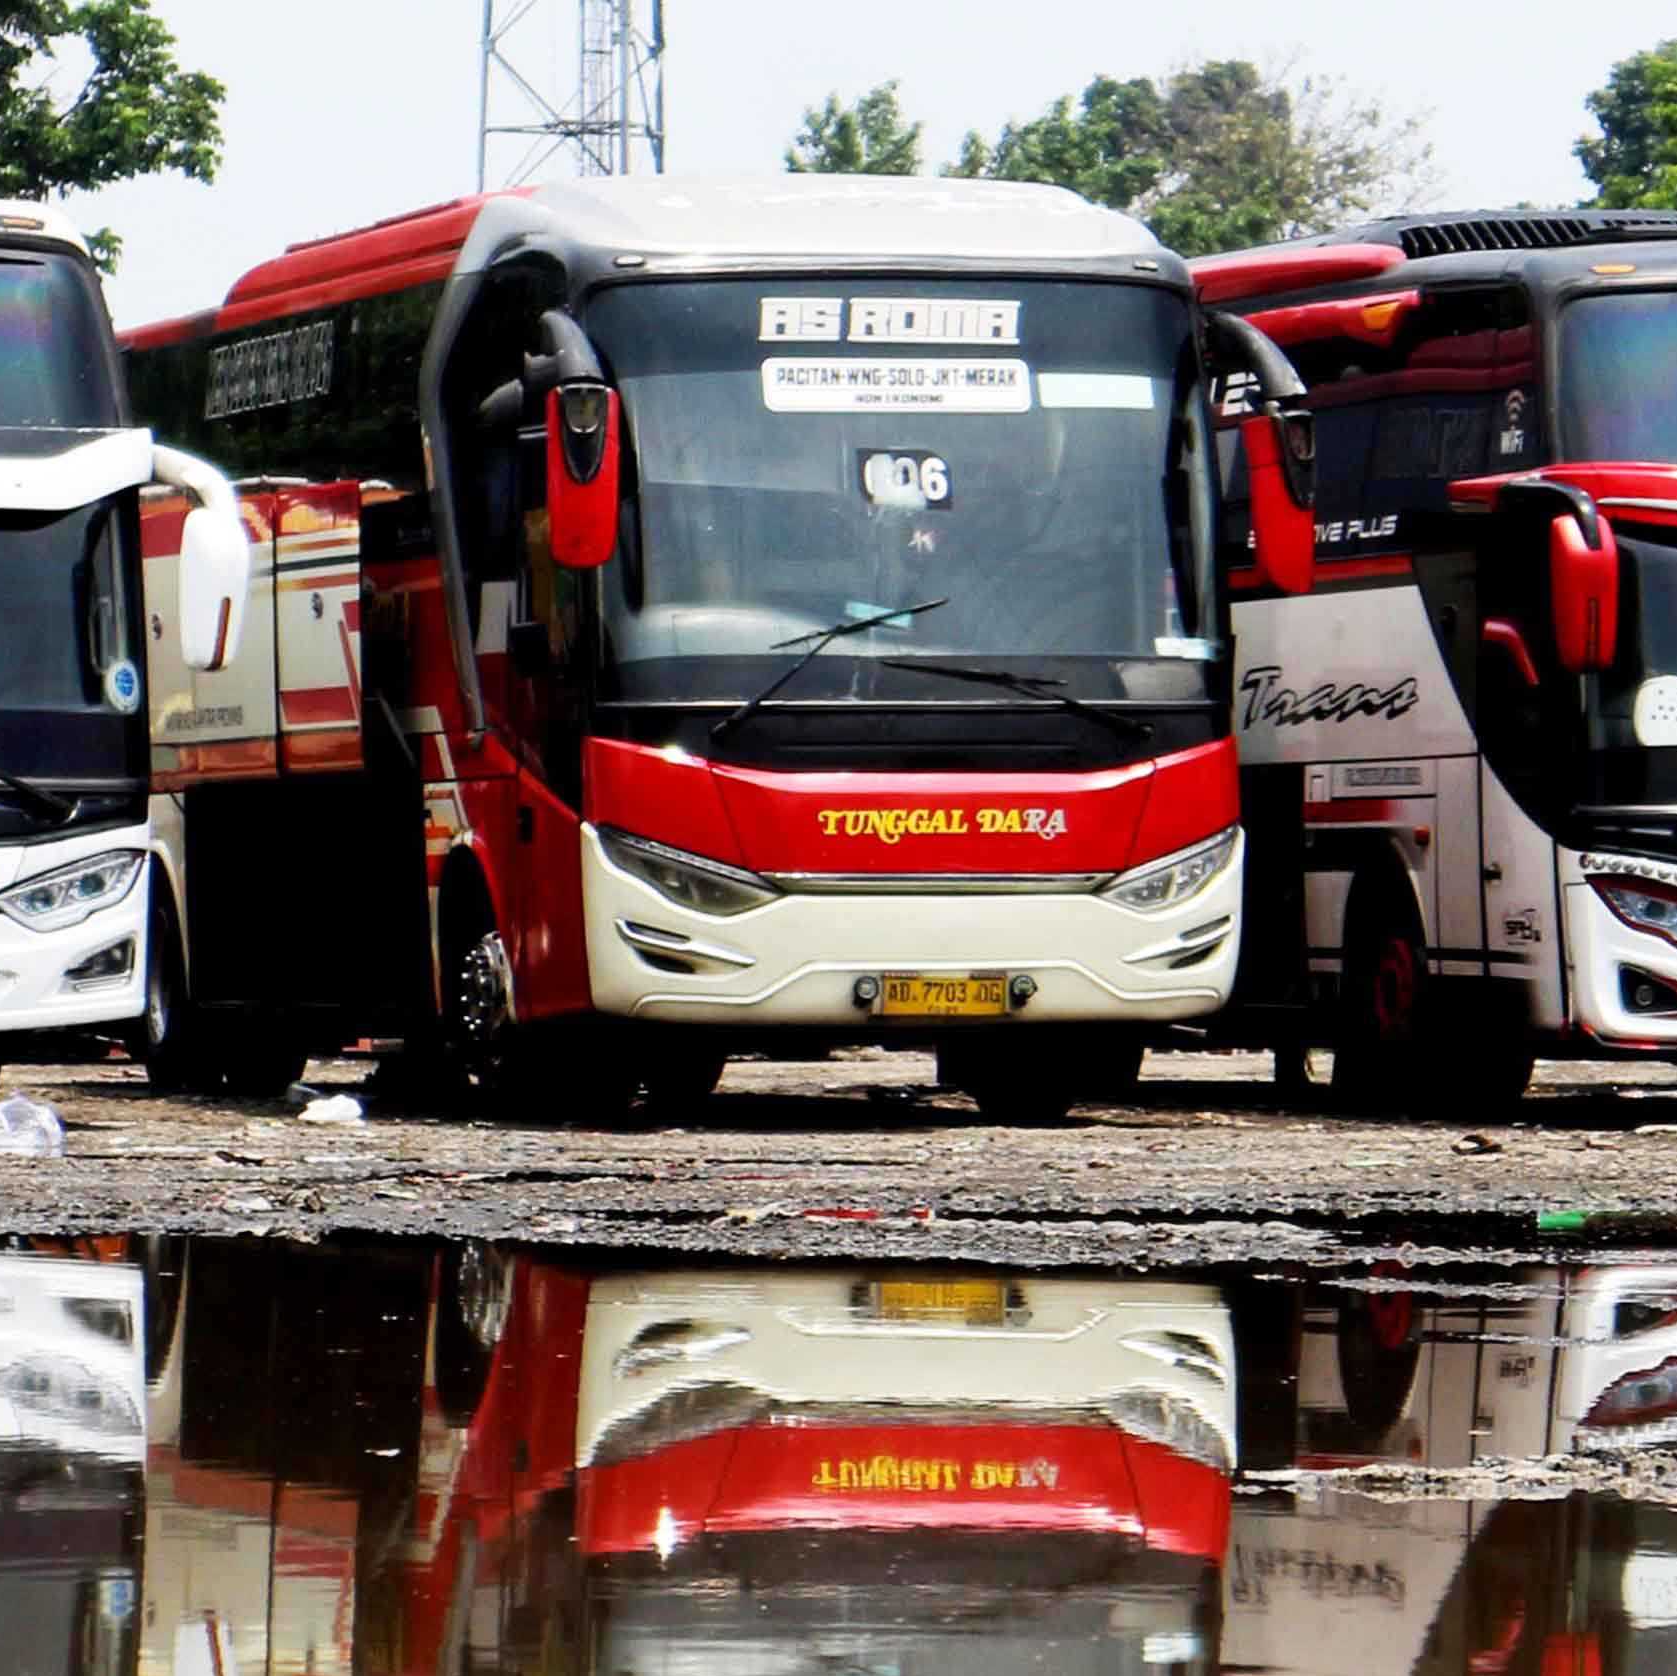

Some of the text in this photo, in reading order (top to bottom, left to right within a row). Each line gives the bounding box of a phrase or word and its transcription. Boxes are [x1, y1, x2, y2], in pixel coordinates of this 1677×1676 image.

[758, 297, 1021, 344] AS ROMA
[817, 807, 1069, 845] TUNGGAL DARA
